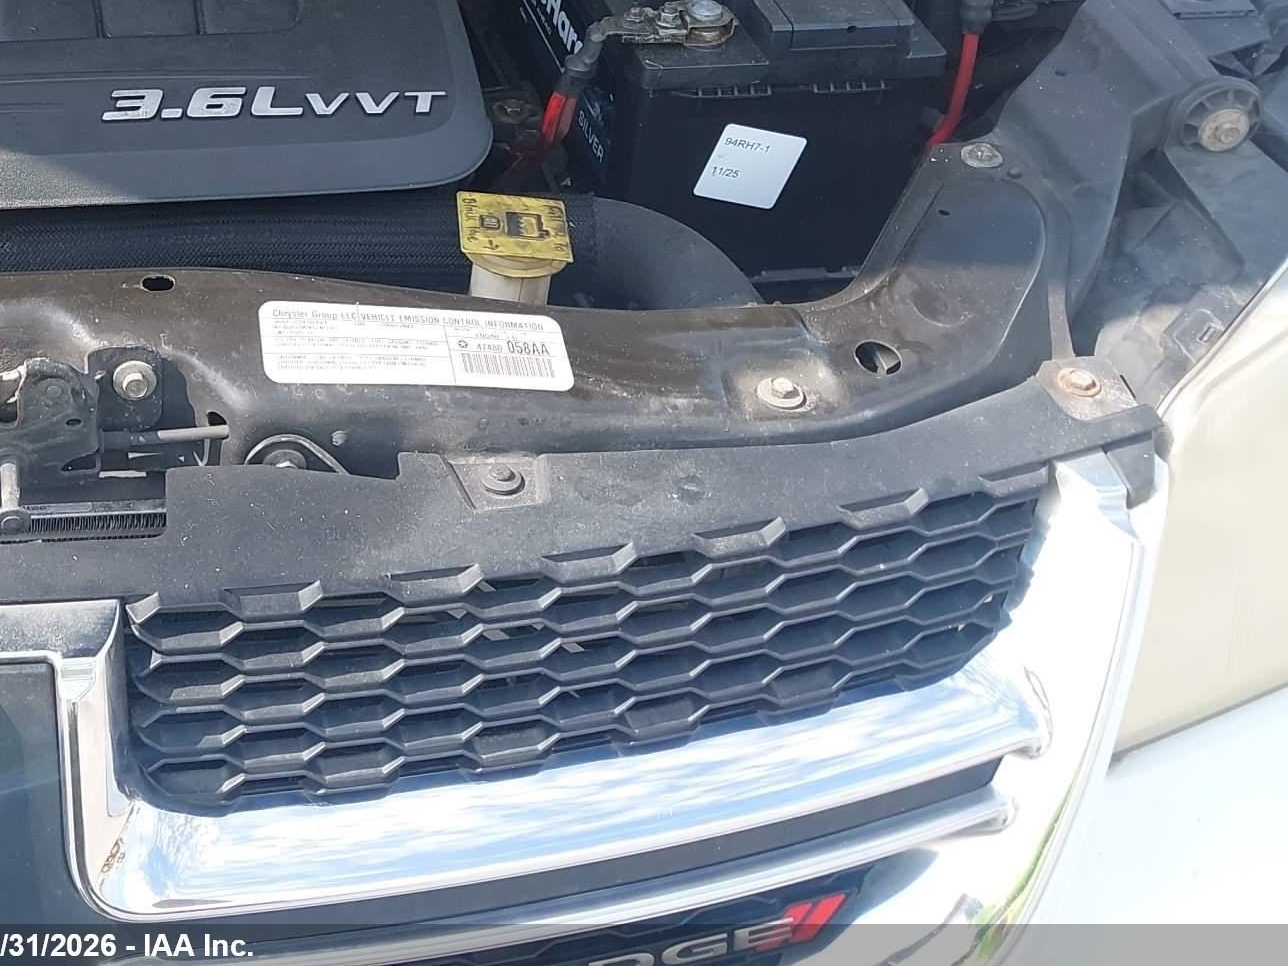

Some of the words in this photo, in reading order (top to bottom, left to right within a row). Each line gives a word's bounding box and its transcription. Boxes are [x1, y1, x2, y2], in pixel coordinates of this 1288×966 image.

[102, 86, 303, 121] 3.6L
[305, 91, 447, 114] VVT
[578, 111, 604, 163] SILVER
[724, 137, 770, 153] 94RH7-1
[712, 166, 740, 179] 11/25
[272, 308, 308, 319] Chrysler
[311, 310, 338, 321] Group
[340, 312, 357, 320] LLC
[361, 313, 395, 322] VEHICLE
[399, 314, 440, 324] EMISSION
[443, 317, 480, 327] CONTROL
[484, 320, 544, 331] INFORMATION
